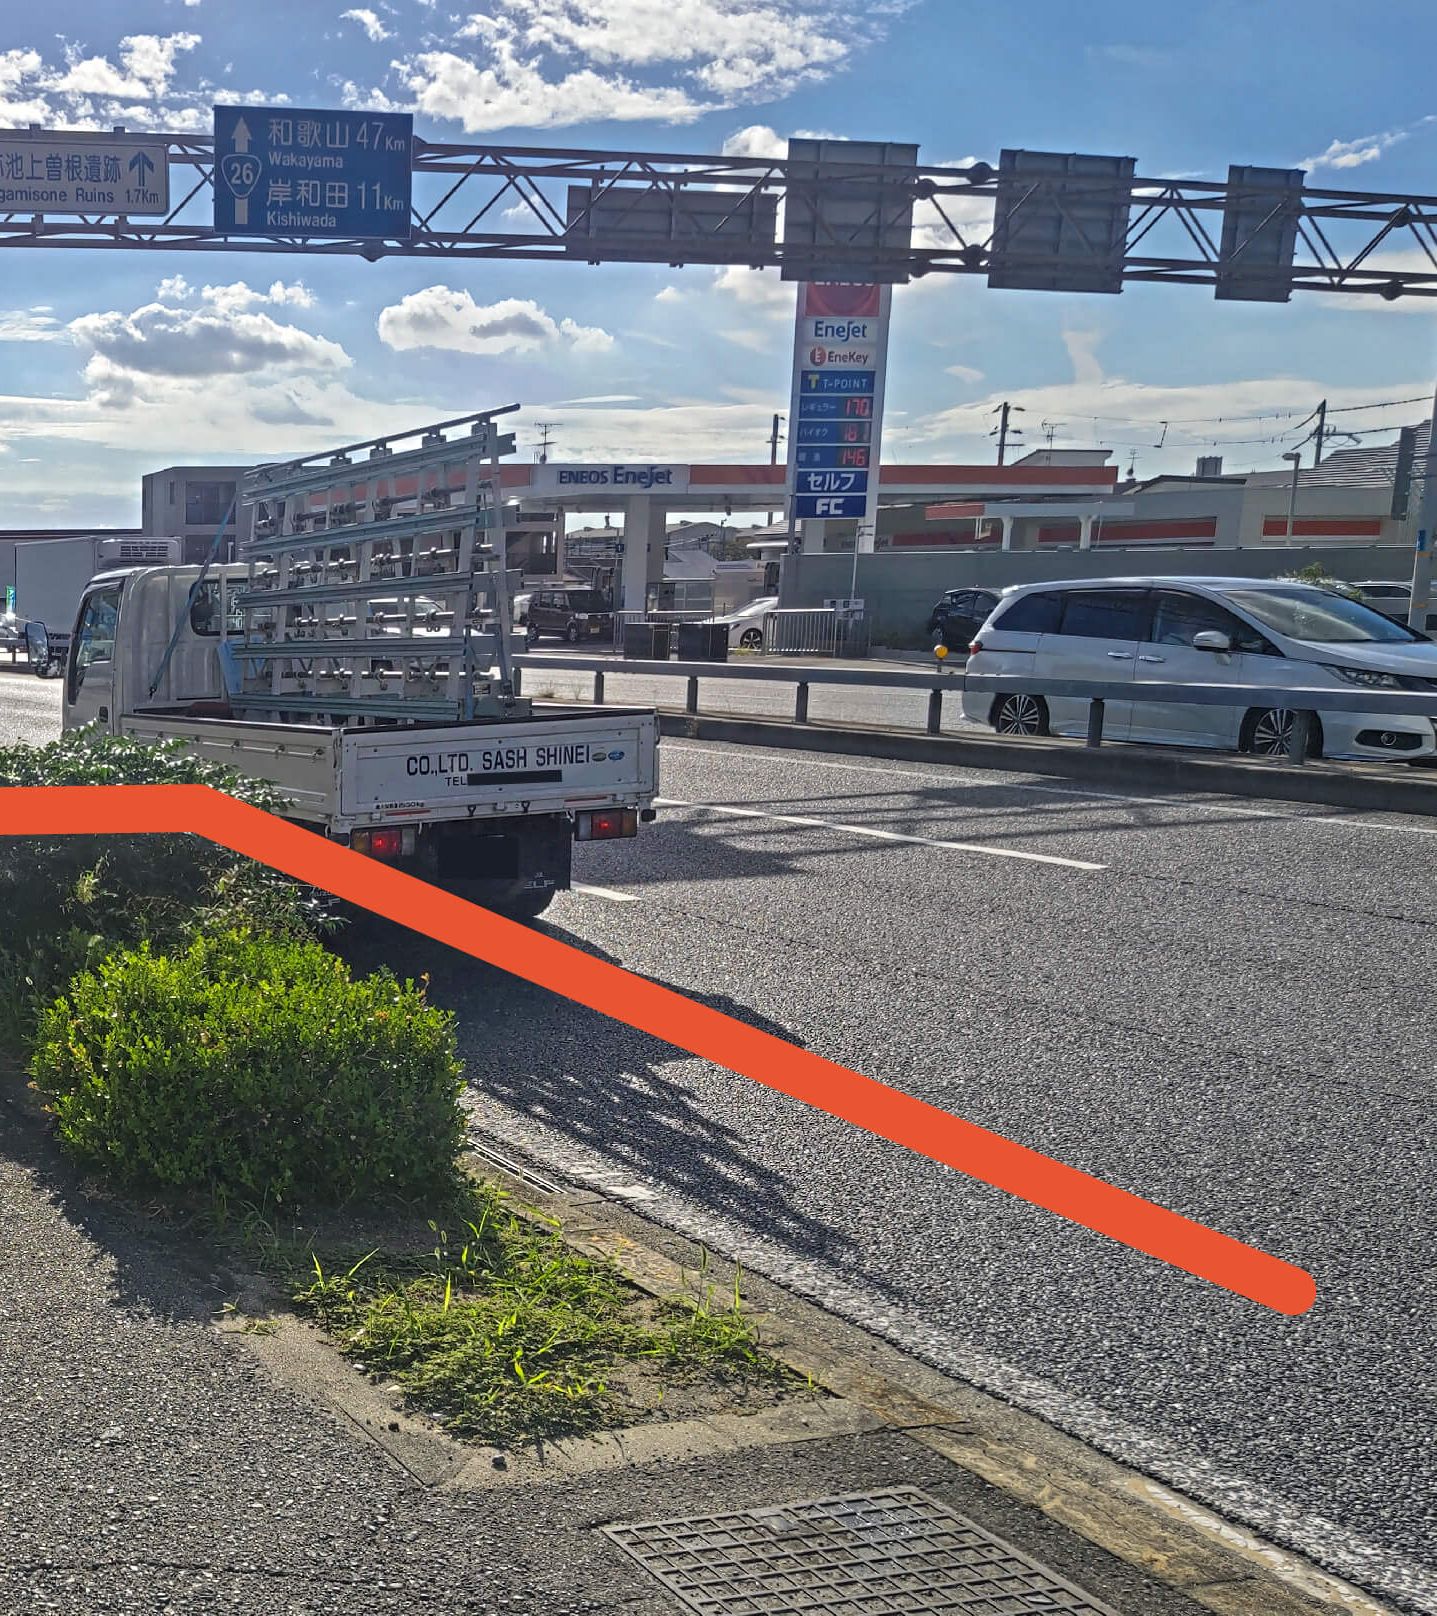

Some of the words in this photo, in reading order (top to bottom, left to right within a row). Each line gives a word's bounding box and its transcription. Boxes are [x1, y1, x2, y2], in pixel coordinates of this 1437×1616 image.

[268, 118, 349, 148] 和歌山
[268, 151, 344, 170] Wakayama
[231, 163, 254, 185] 26
[76, 187, 114, 203] Ruins
[125, 189, 159, 204] 1.7Km
[266, 178, 348, 208] 岸和田
[266, 210, 337, 227] Kishiwada
[828, 351, 868, 365] EneKey
[559, 470, 609, 485] ENEOS
[808, 473, 855, 491] セルフ
[816, 498, 844, 515] FC
[482, 750, 527, 770] SASH
[535, 745, 590, 766] SHINEI
[445, 776, 467, 786] TEL
